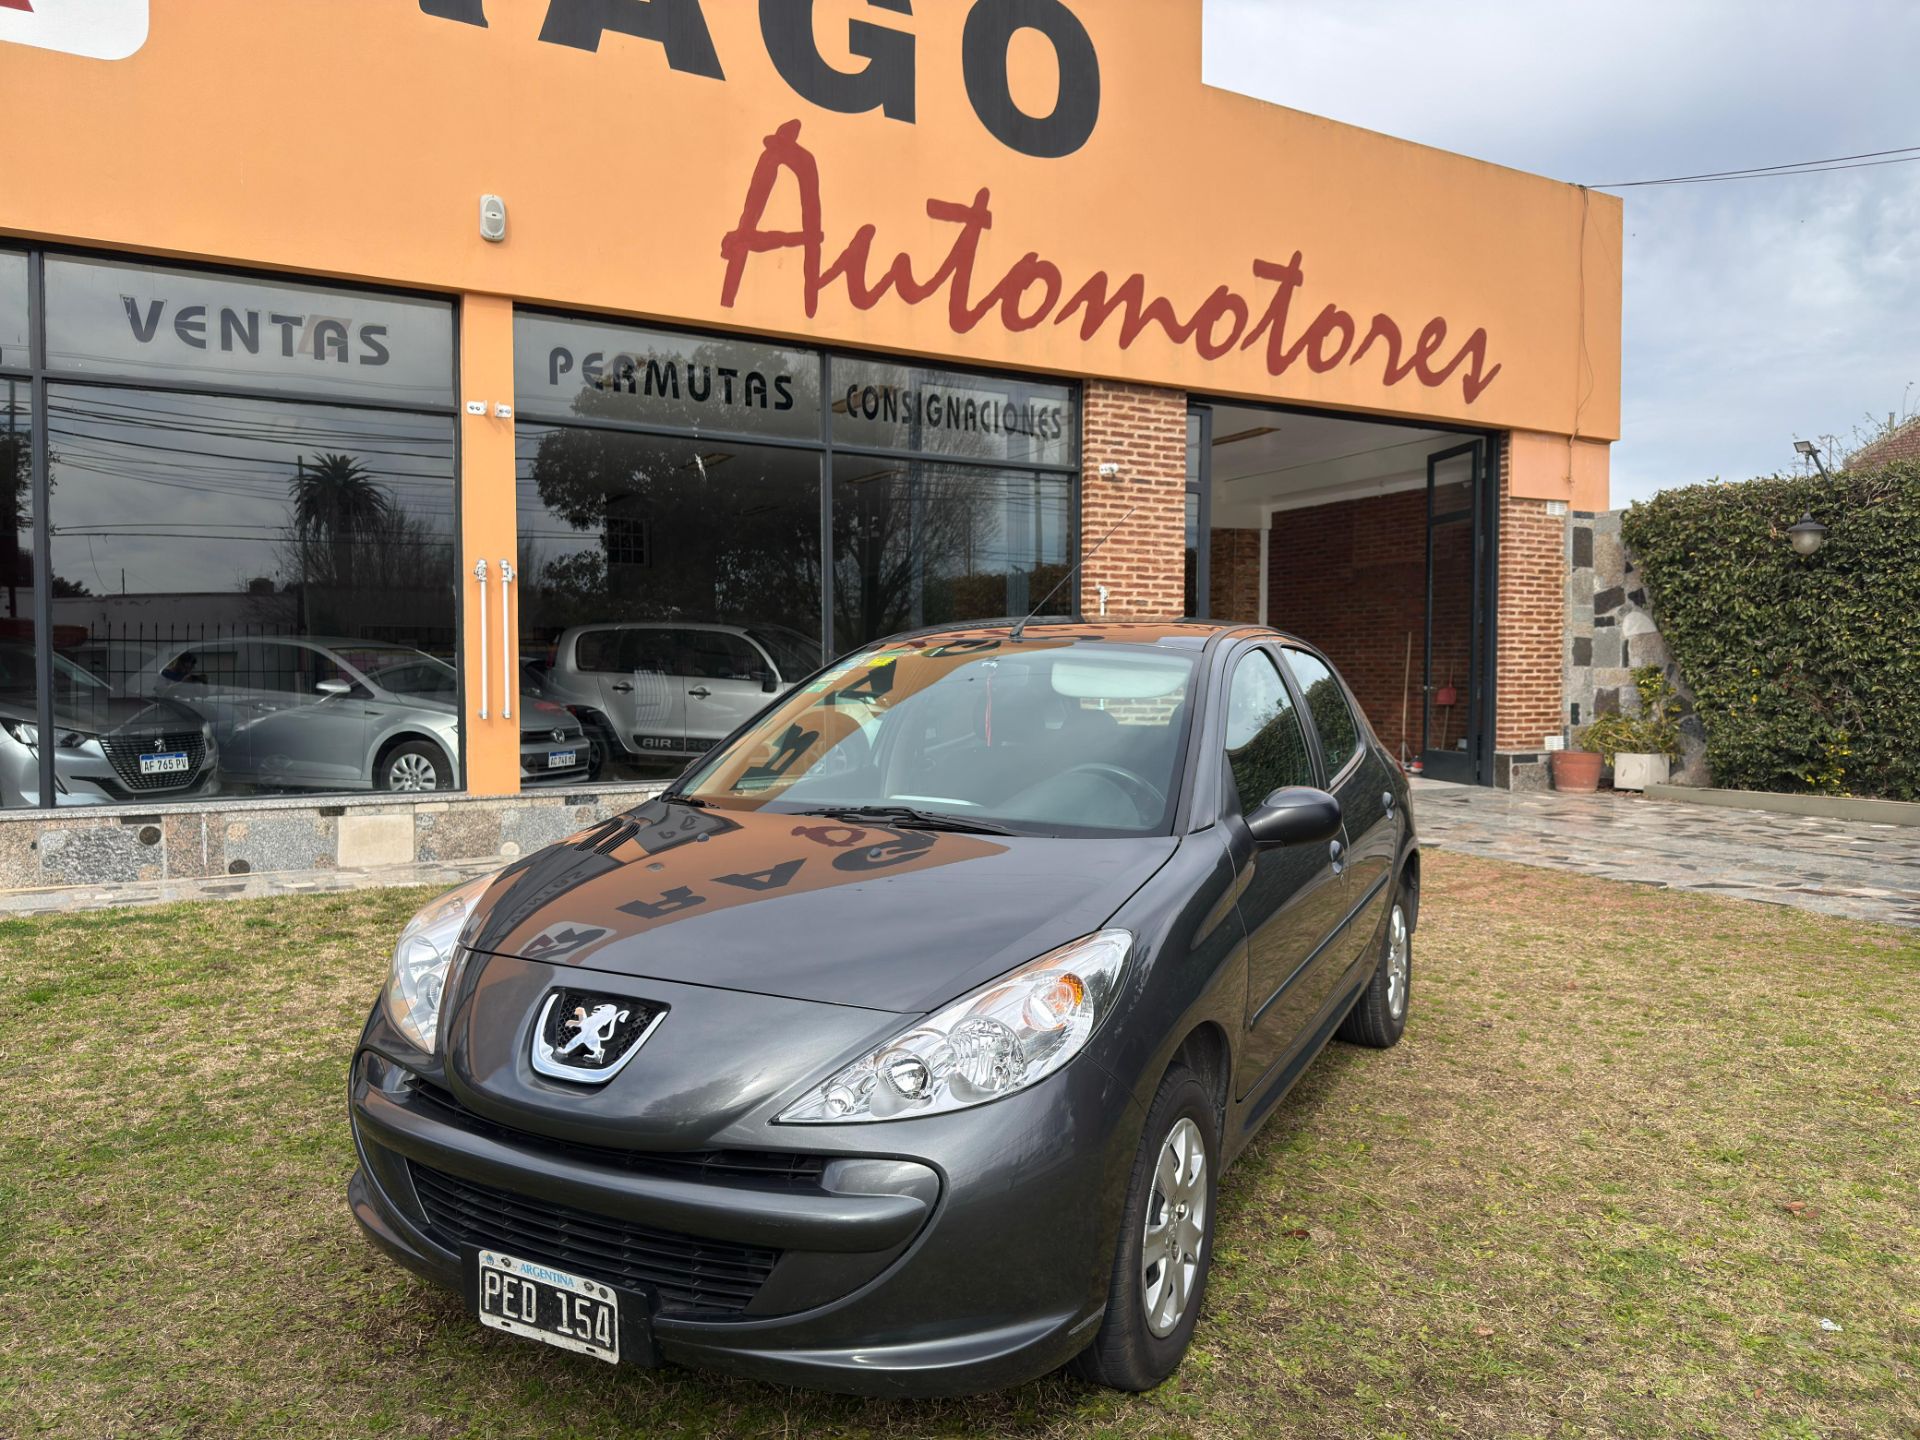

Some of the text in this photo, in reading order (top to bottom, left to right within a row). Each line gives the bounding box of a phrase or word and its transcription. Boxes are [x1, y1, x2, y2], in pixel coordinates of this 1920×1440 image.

[720, 118, 1502, 404] Automotores
[122, 295, 390, 366] VENTAS
[548, 346, 794, 411] PERMUTAS
[845, 384, 1062, 441] CONSIGNACIONES
[144, 760, 154, 772] AF
[157, 759, 173, 771] 765
[520, 1263, 575, 1288] ARGENTINA
[484, 1270, 612, 1348] PED 154
